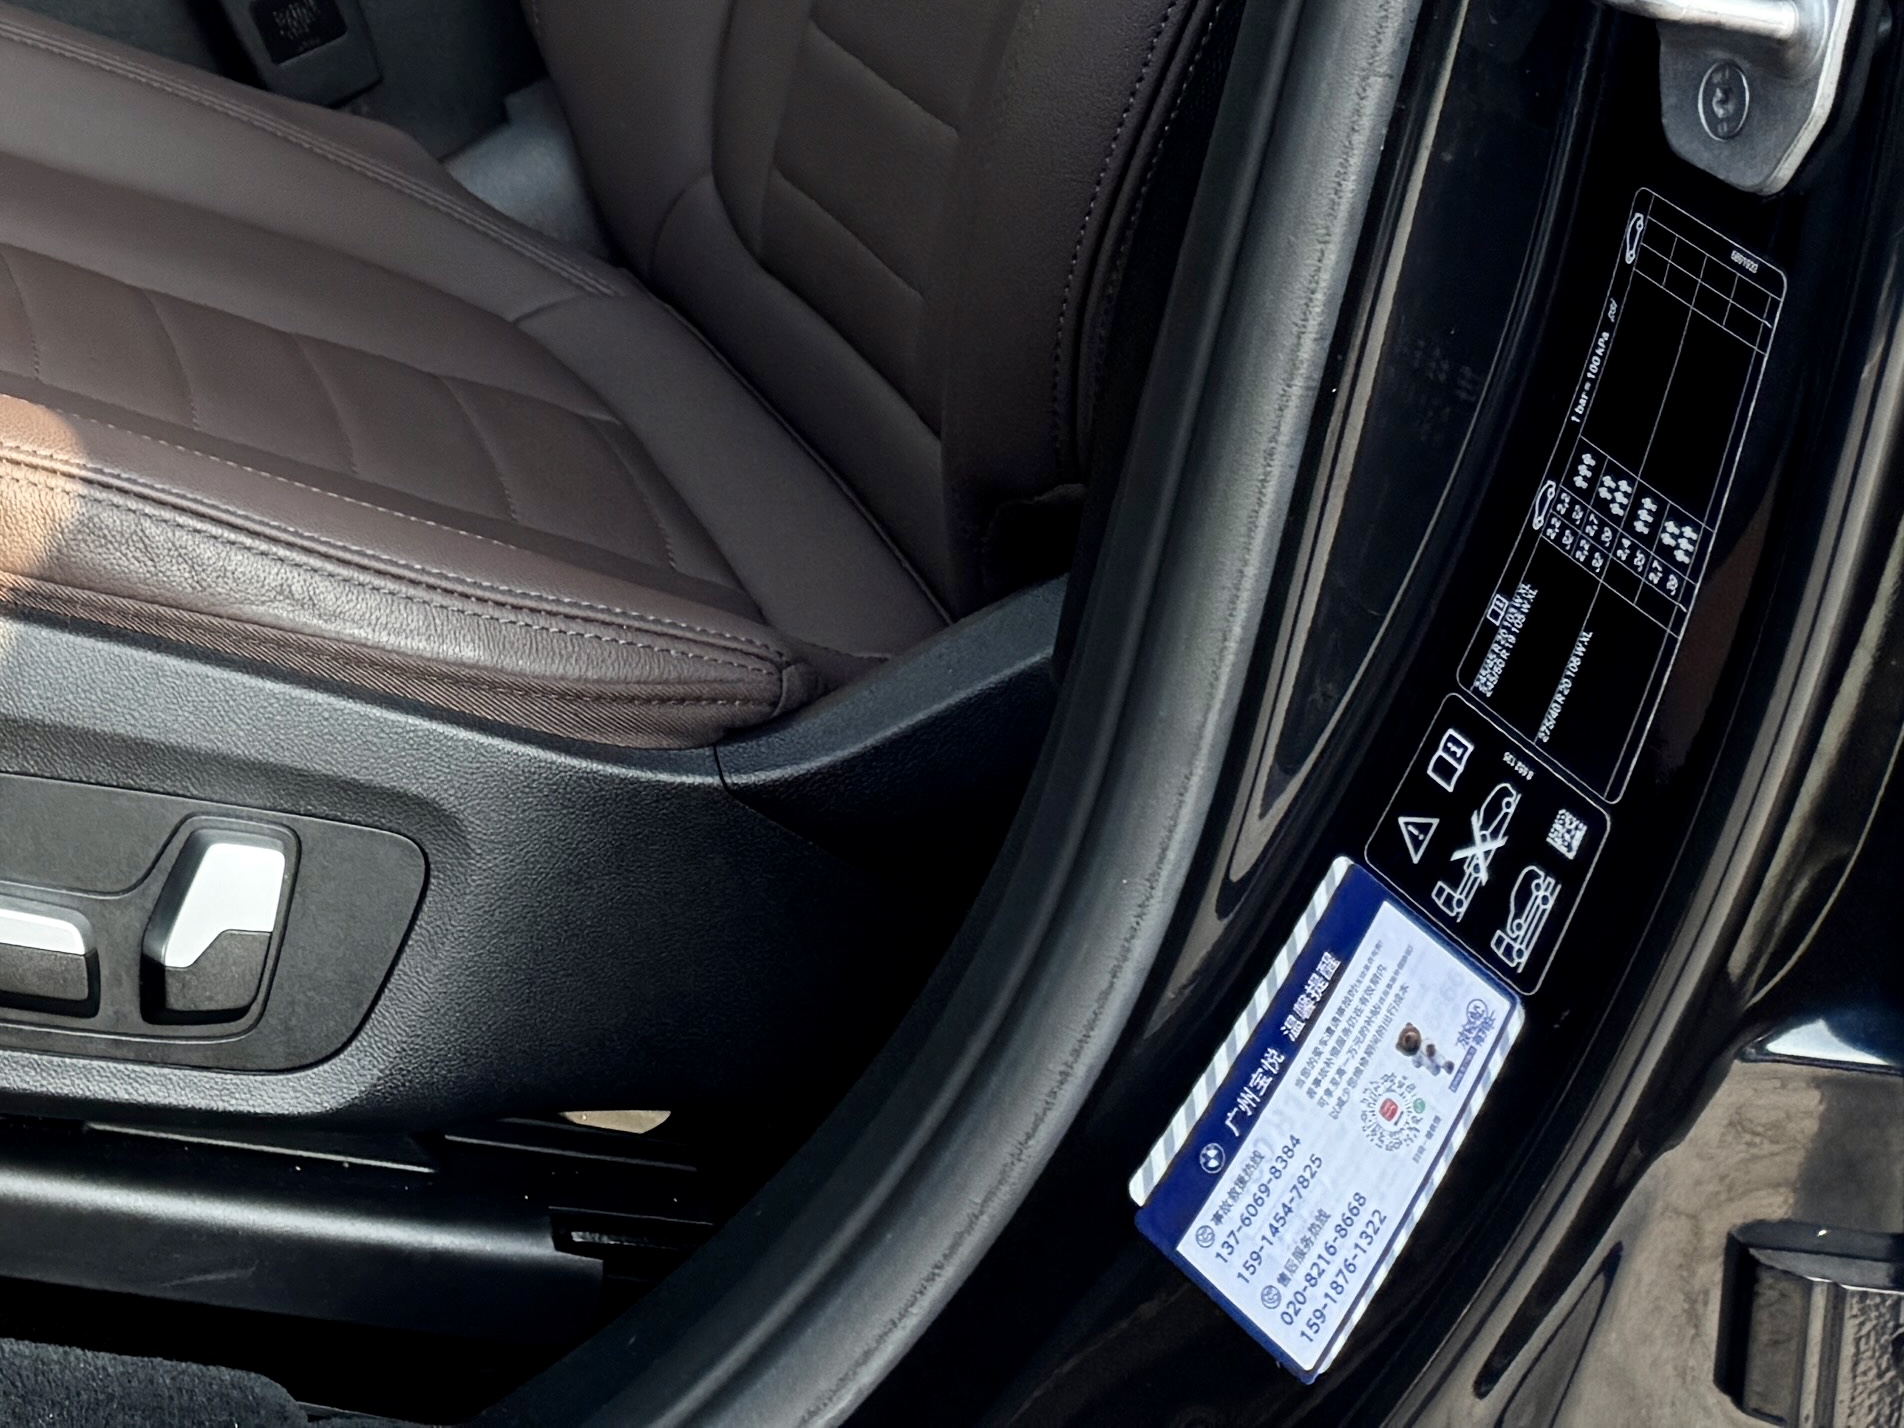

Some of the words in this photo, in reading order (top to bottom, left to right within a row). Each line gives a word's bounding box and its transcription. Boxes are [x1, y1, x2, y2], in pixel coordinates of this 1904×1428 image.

[1574, 391, 1588, 414] bar
[1586, 355, 1600, 378] 100
[1545, 517, 1561, 539] 2,2
[1556, 492, 1570, 514] 2,2
[1575, 539, 1590, 561] 2,2
[1225, 1047, 1285, 1136] 广州宝悦
[1280, 951, 1340, 1041] 温馨提醒
[1215, 1134, 1300, 1263] 137-6069-8384
[1236, 1153, 1322, 1283] 159-1454-7825
[1276, 1208, 1331, 1287] 售后服务热线
[1280, 1191, 1366, 1325] 020-8216-8668
[1300, 1209, 1387, 1342] 159-1876-1322
